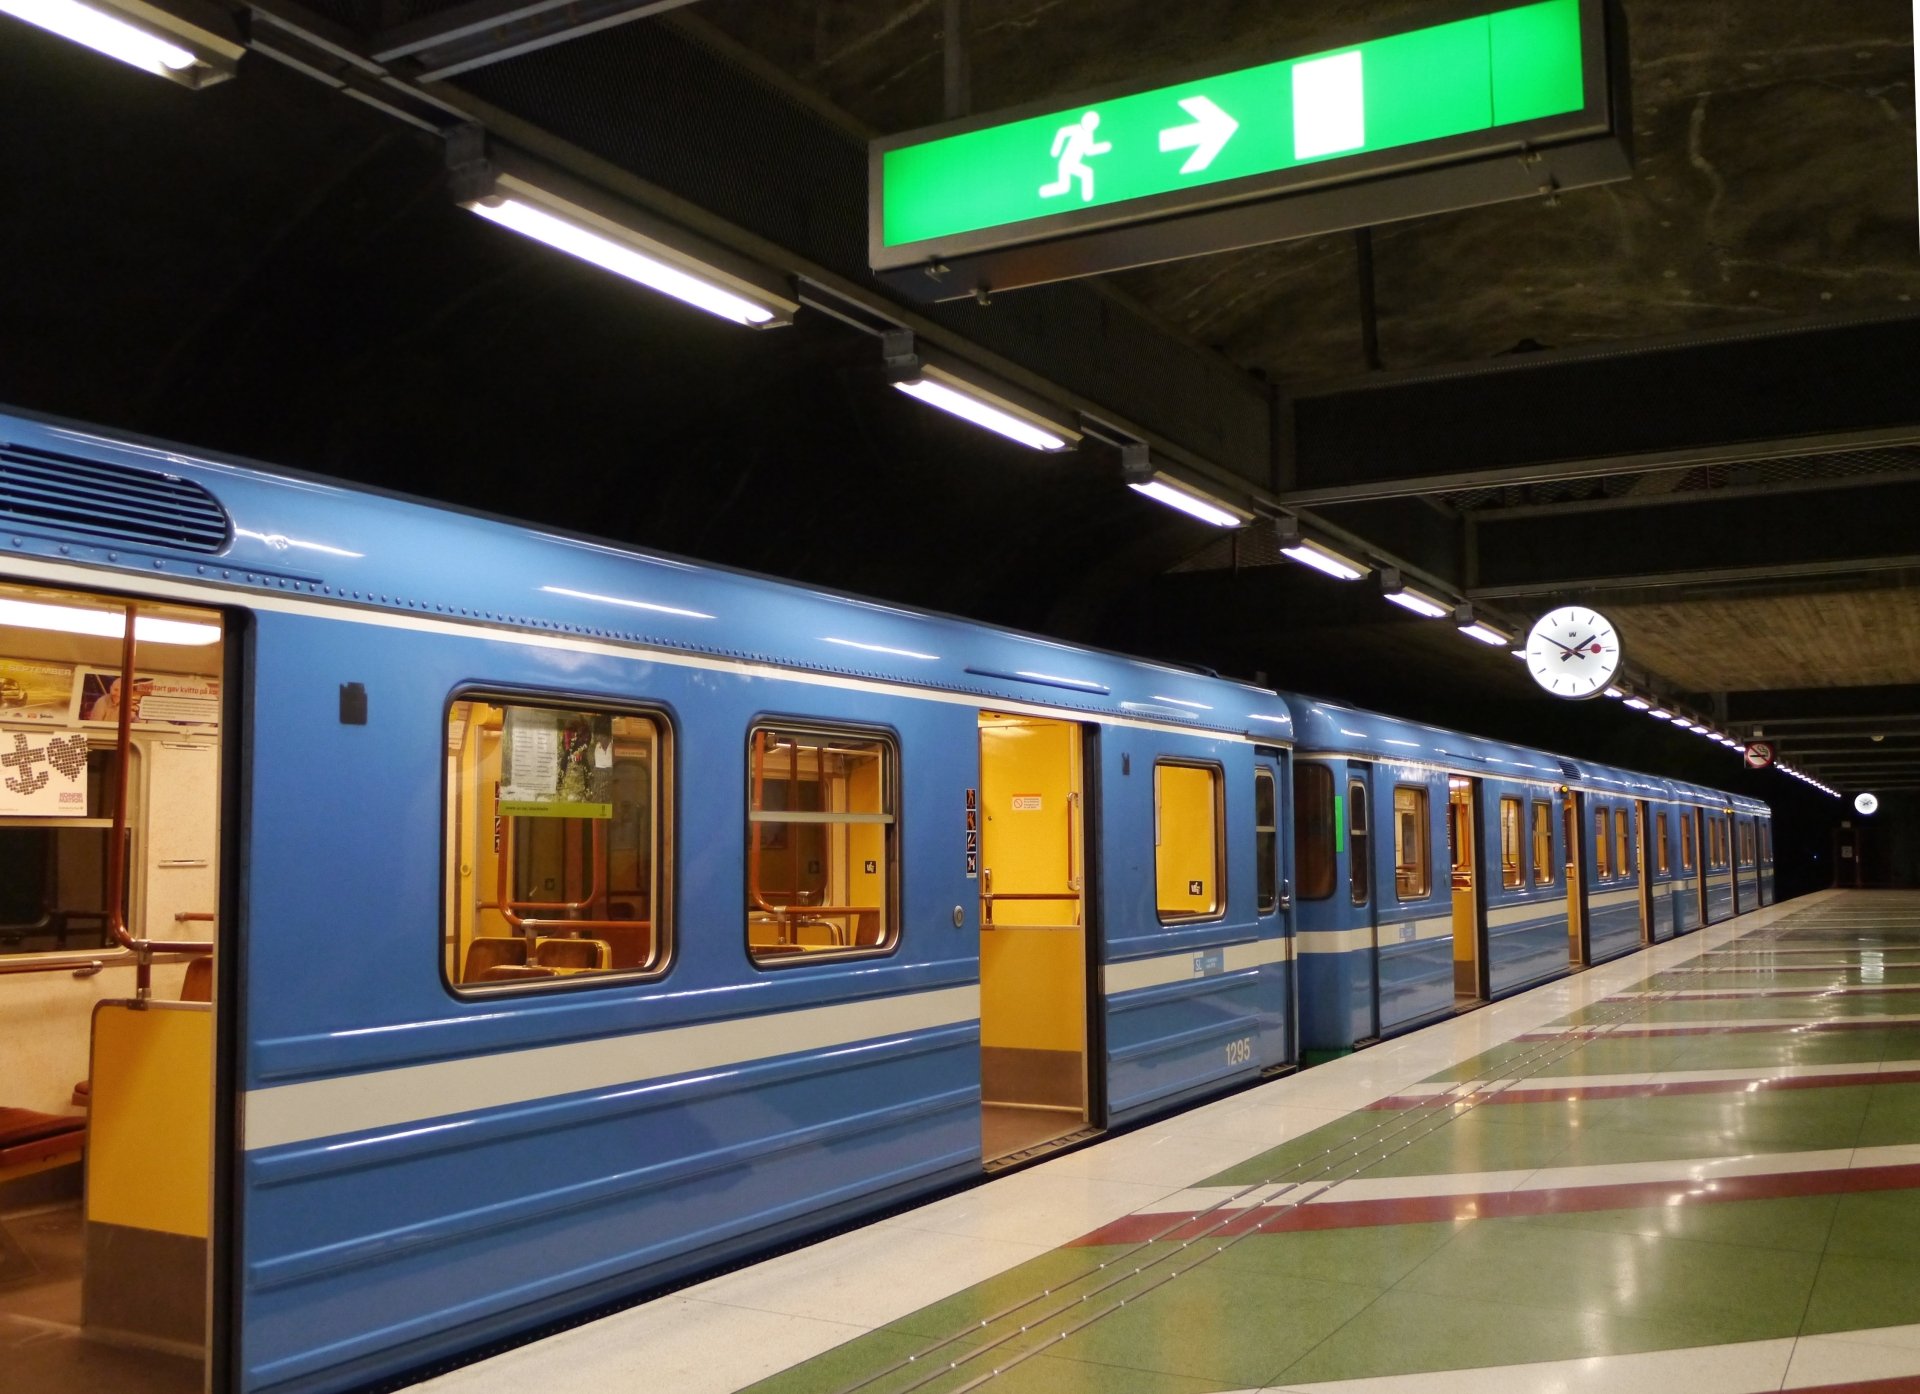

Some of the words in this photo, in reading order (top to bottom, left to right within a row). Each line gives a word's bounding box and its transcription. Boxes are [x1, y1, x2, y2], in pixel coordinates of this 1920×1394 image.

[9, 665, 72, 676] SEPTEMBER
[180, 686, 199, 694] kvitto
[1195, 959, 1202, 970] SL
[1226, 1038, 1250, 1065] 1295
